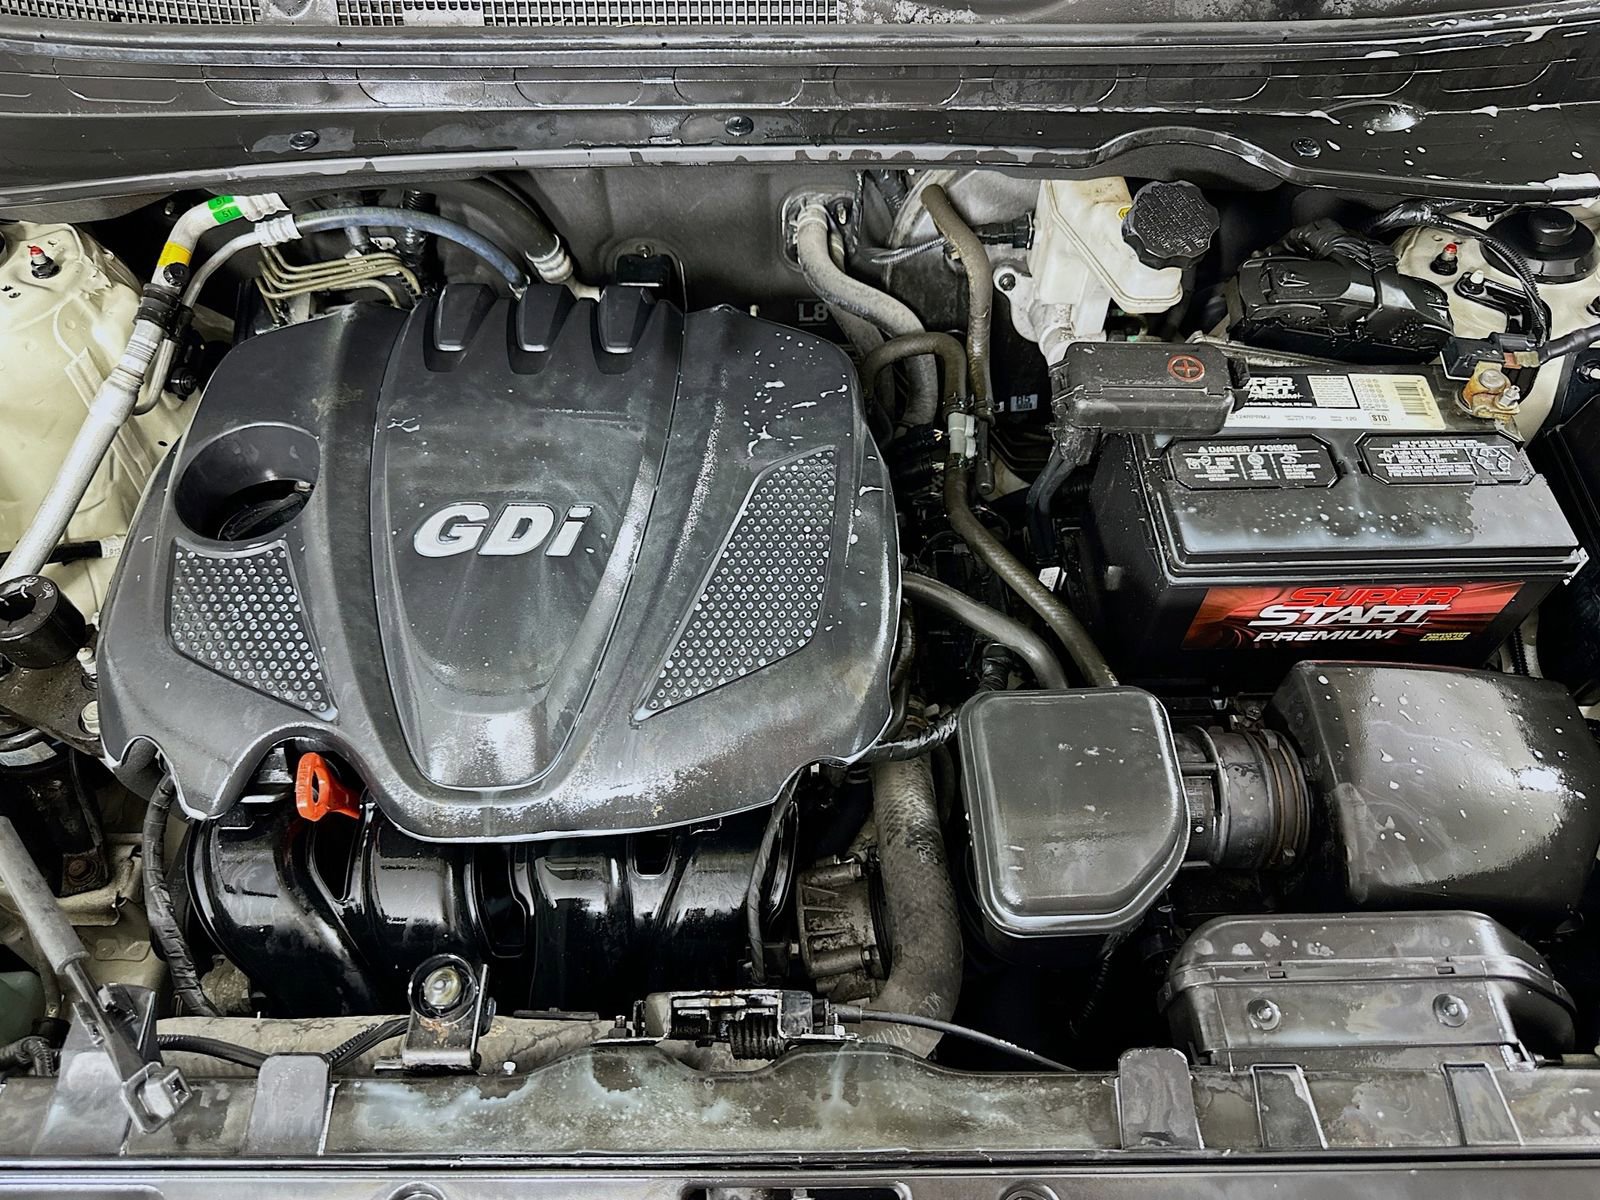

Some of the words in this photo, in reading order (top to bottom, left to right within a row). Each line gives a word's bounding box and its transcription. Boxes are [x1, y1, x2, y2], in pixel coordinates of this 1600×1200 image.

[222, 208, 232, 217] 51
[798, 302, 829, 322] L8
[1371, 414, 1388, 422] STD
[1208, 445, 1250, 453] DANGER
[1259, 444, 1298, 452] POISON
[413, 502, 594, 557] GDi
[1283, 587, 1463, 606] SUPER
[1248, 604, 1450, 626] START
[1253, 629, 1398, 642] PREMIUM
